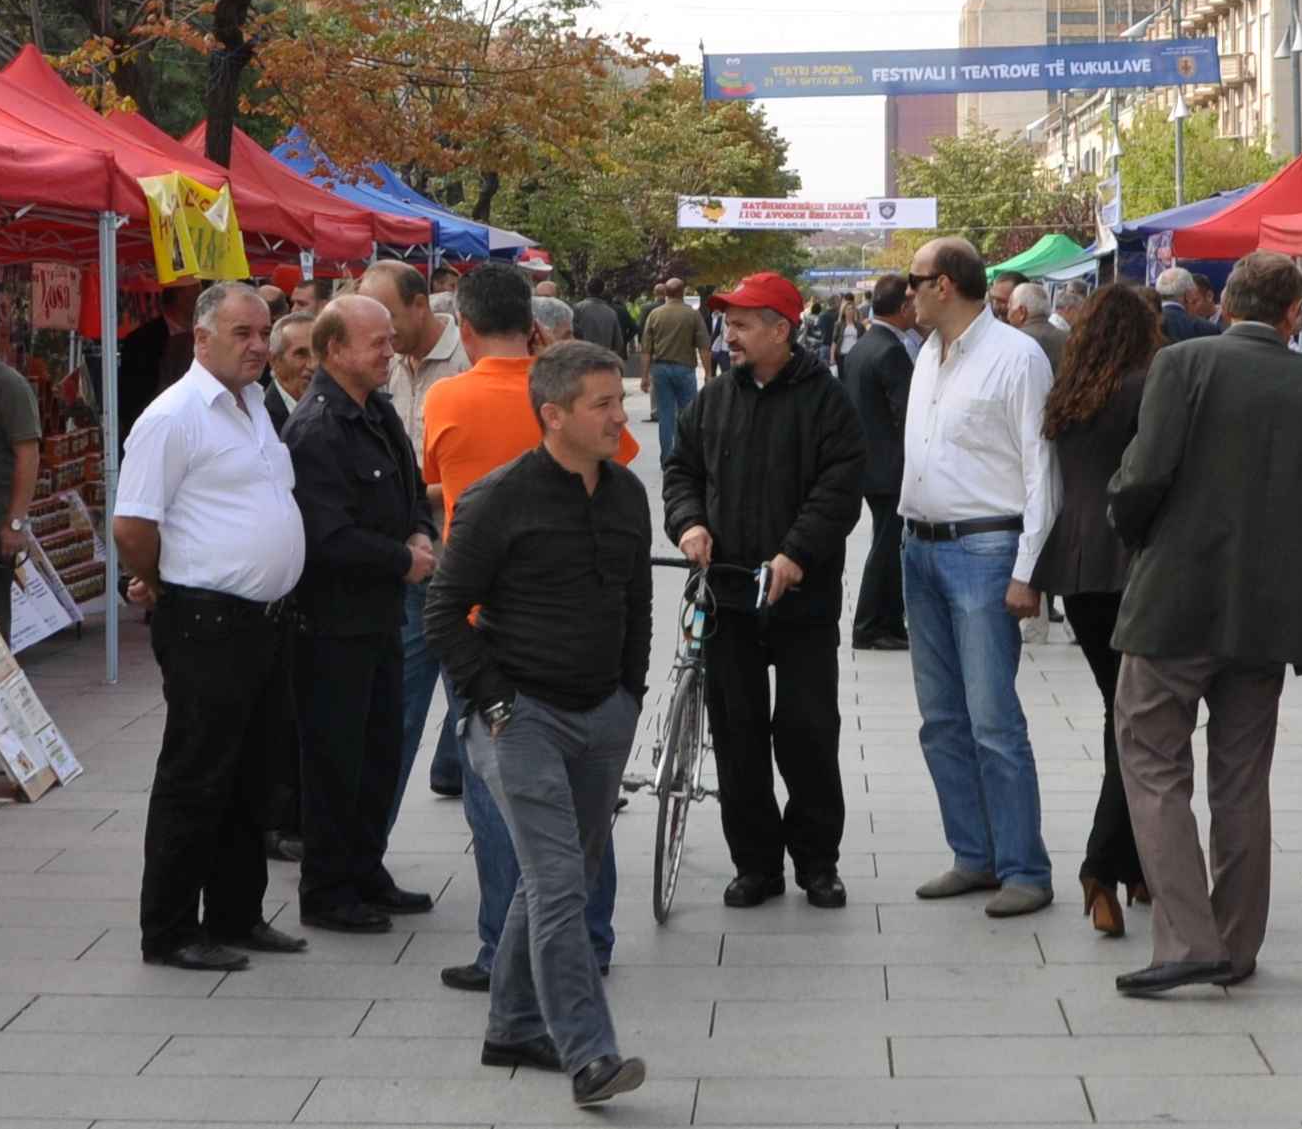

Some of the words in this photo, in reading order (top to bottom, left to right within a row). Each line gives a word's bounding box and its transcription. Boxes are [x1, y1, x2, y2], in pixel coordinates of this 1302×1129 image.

[872, 65, 945, 83] FESTIVALI
[951, 66, 956, 80] I
[961, 62, 1040, 80] TEATROVE
[1048, 59, 1066, 77] TË
[1070, 58, 1152, 76] KUKULLAVE
